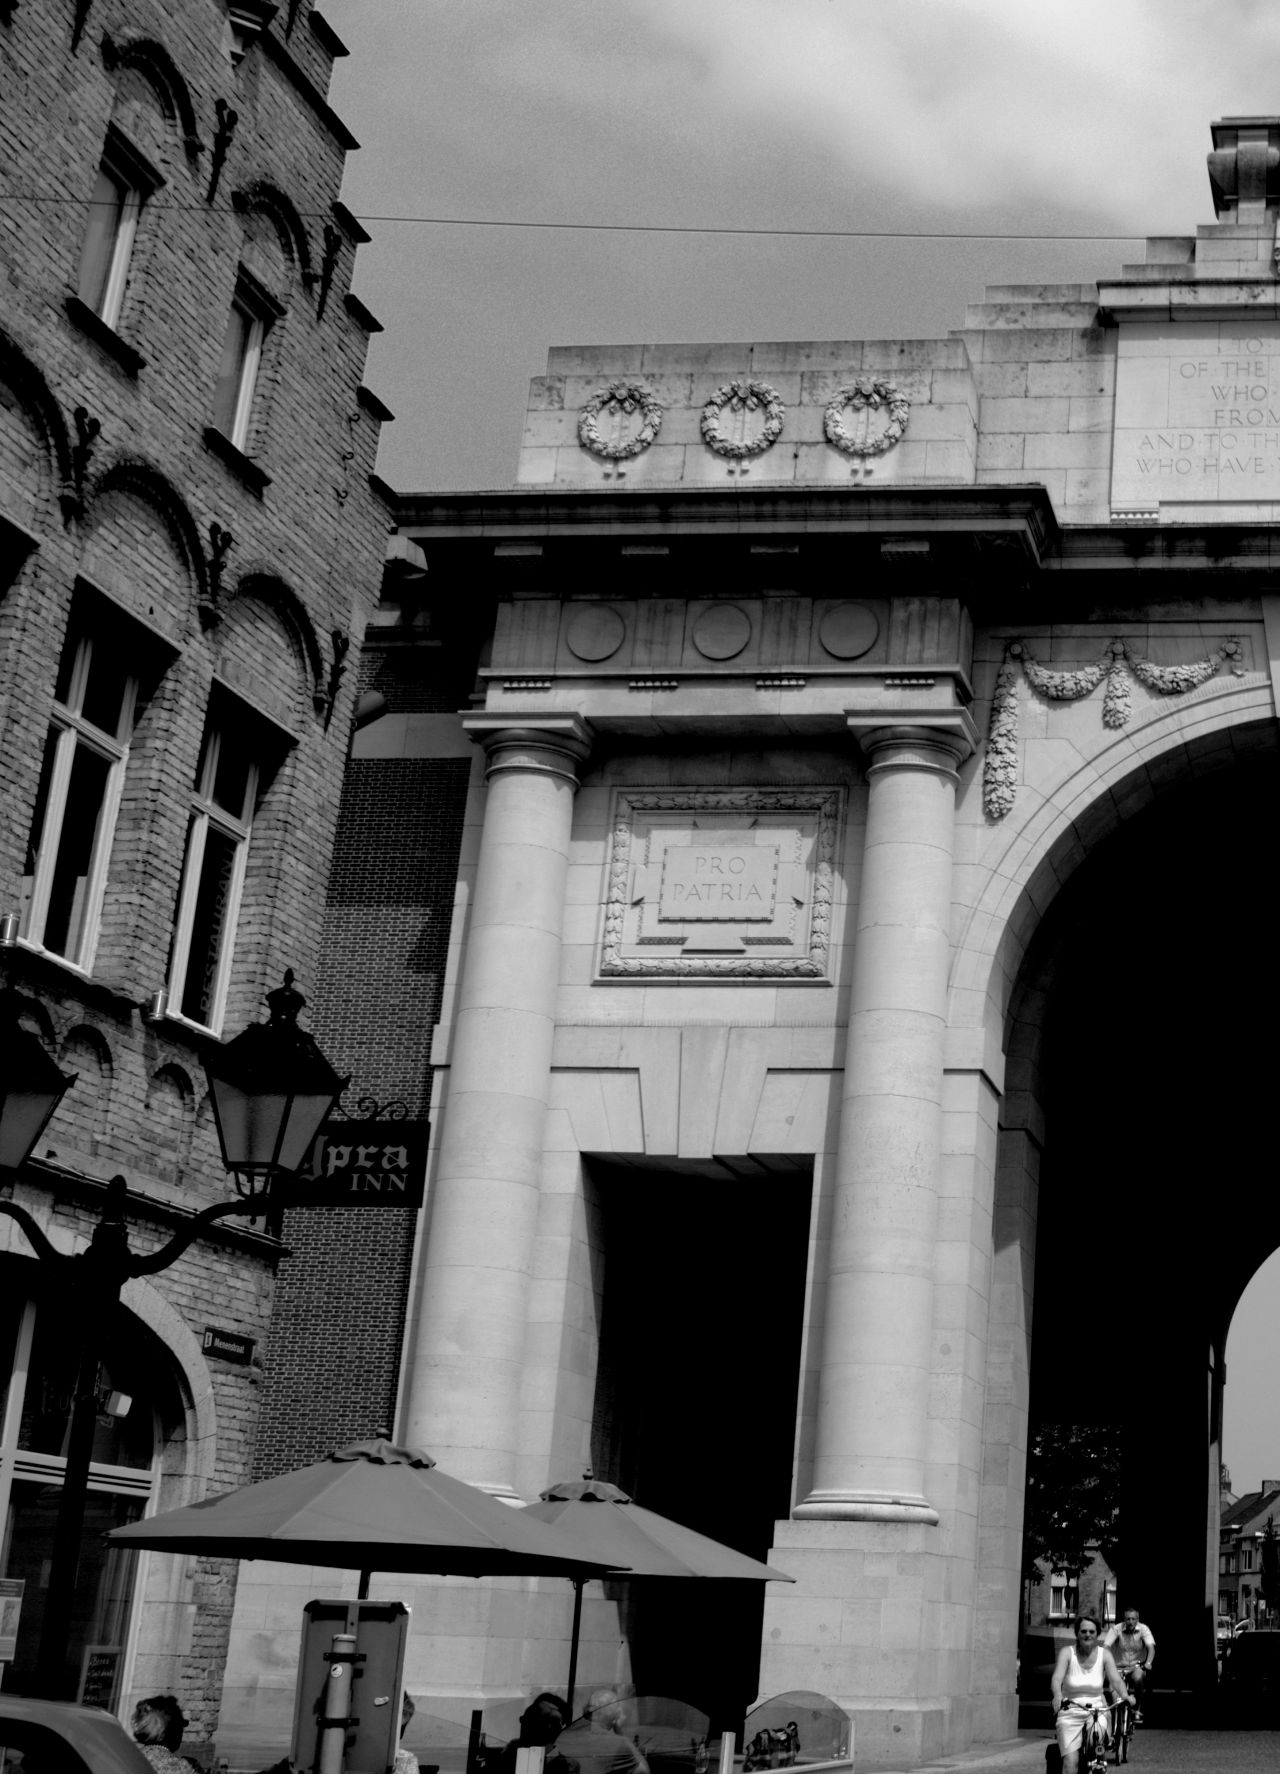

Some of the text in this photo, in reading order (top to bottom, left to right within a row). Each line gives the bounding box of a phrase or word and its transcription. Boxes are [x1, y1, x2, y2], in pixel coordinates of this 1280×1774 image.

[1229, 337, 1264, 354] TO
[1180, 361, 1209, 379] OF
[1220, 361, 1266, 378] THE
[1210, 384, 1268, 402] WHO
[1138, 433, 1195, 451] AND
[1203, 432, 1239, 450] TO
[1135, 456, 1193, 475] WHO
[1202, 456, 1266, 475] HAVE
[695, 856, 746, 875] PRO
[672, 883, 763, 902] PATRIA
[349, 1173, 409, 1191] INN
